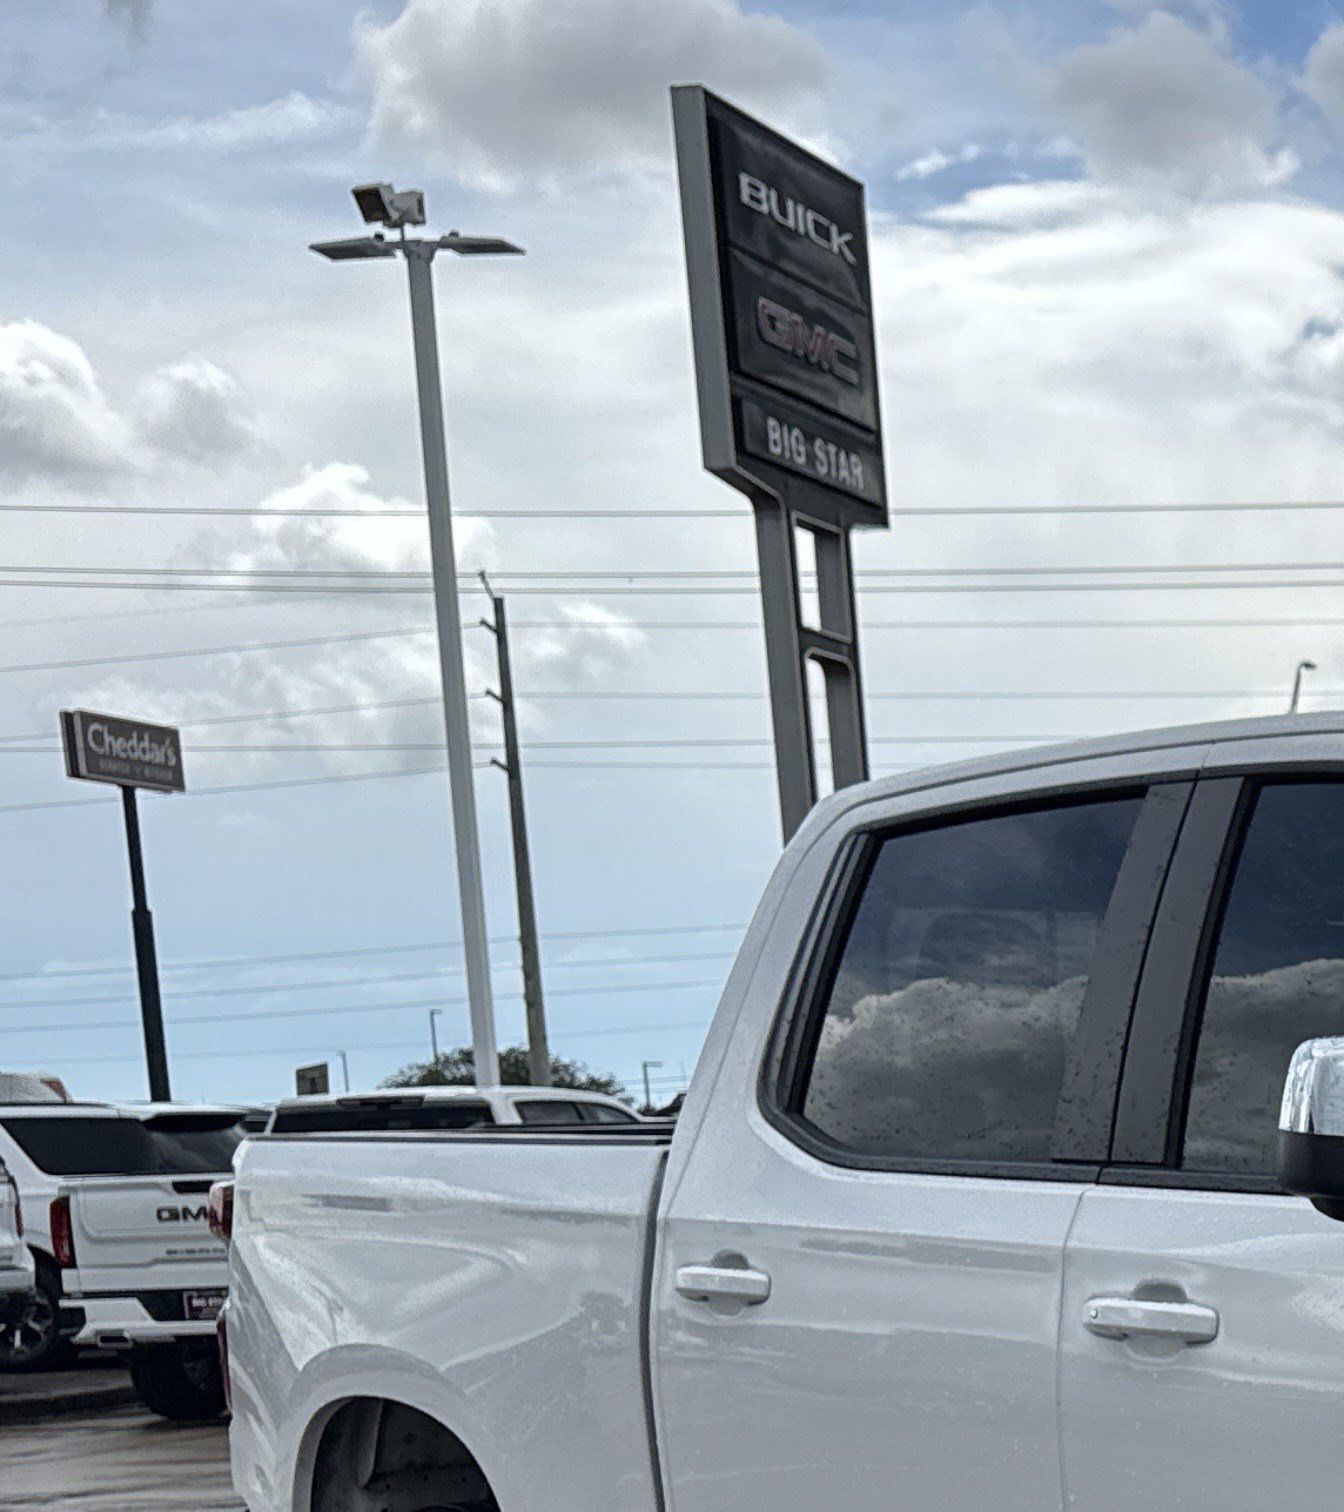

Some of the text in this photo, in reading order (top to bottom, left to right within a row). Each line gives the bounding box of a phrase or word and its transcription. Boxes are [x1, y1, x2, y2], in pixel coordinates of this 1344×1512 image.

[739, 172, 857, 264] BUICK
[757, 298, 860, 386] GMC
[766, 415, 864, 490] BIG STAR
